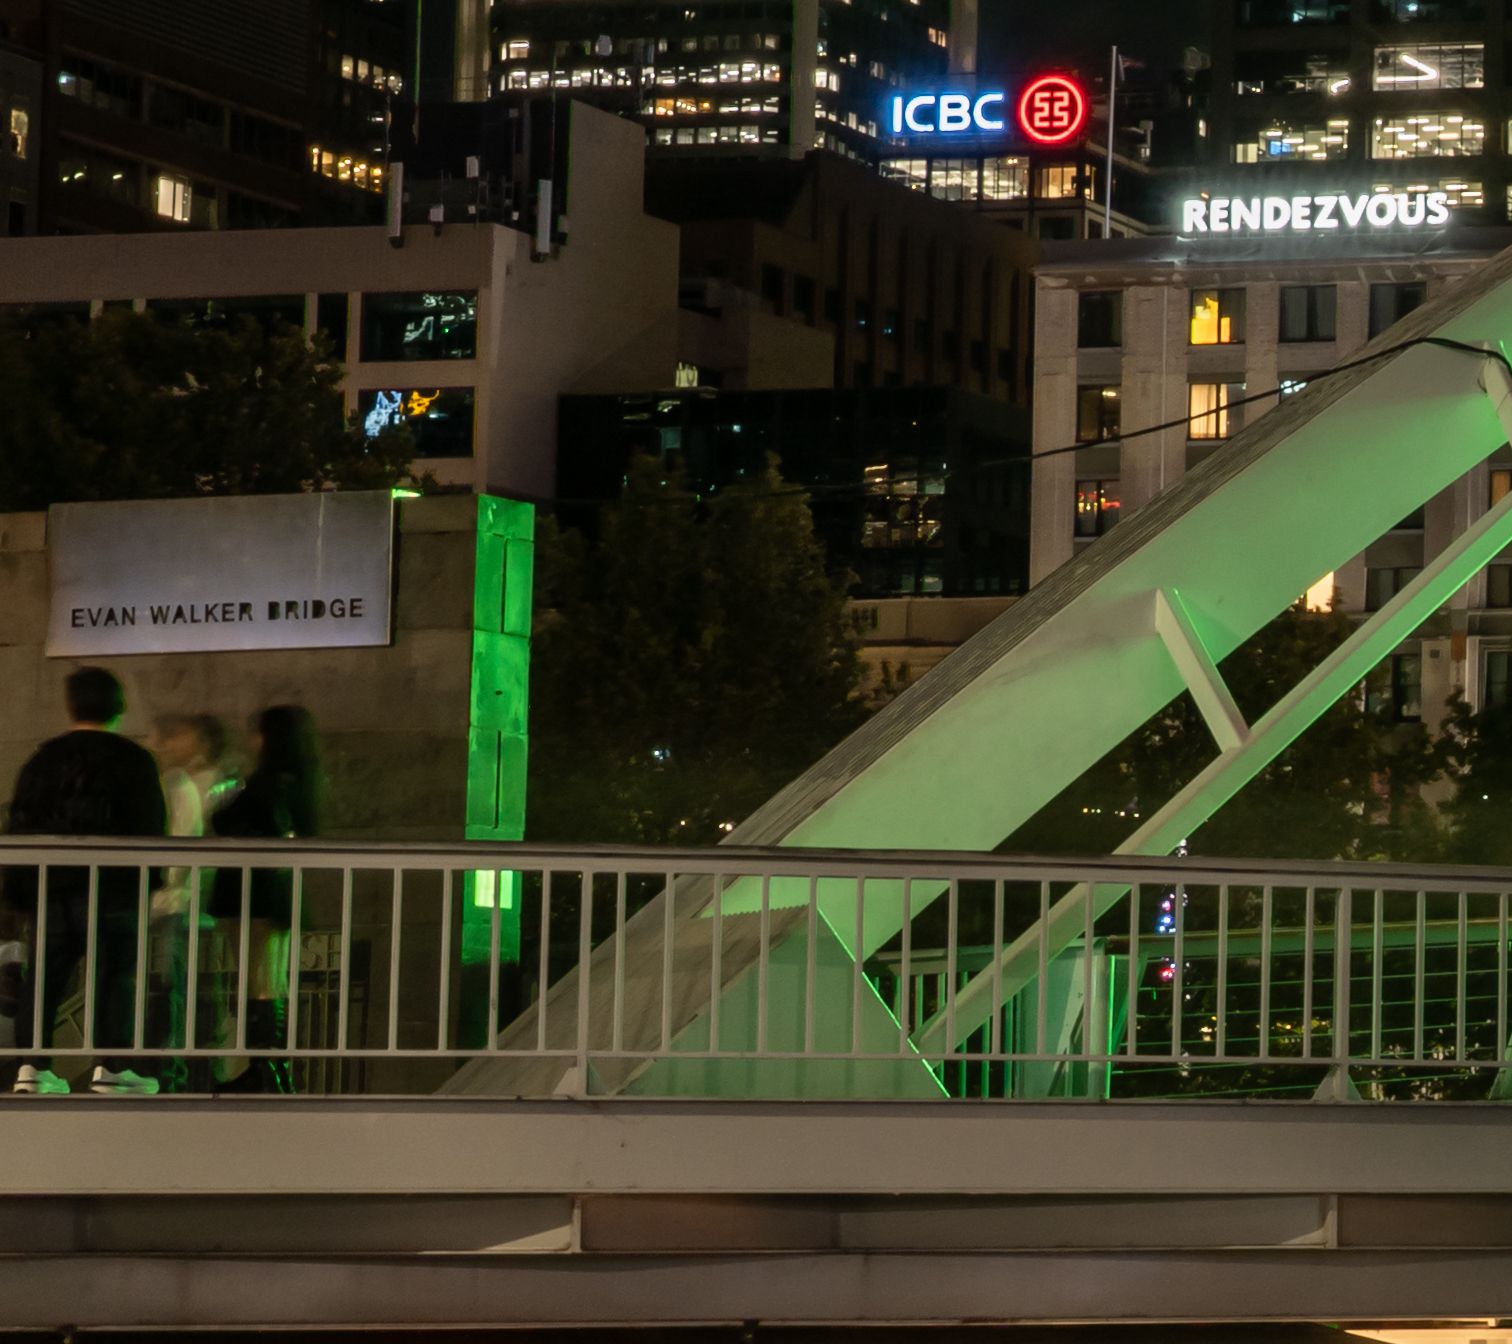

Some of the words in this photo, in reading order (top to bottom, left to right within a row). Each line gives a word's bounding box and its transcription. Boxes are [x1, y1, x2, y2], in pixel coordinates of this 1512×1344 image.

[893, 93, 1004, 133] ICBC
[1182, 192, 1450, 233] RENDEZVOUS
[71, 605, 136, 628] EVAN
[151, 602, 253, 625] WALKER
[267, 598, 363, 621] BRIDGE
